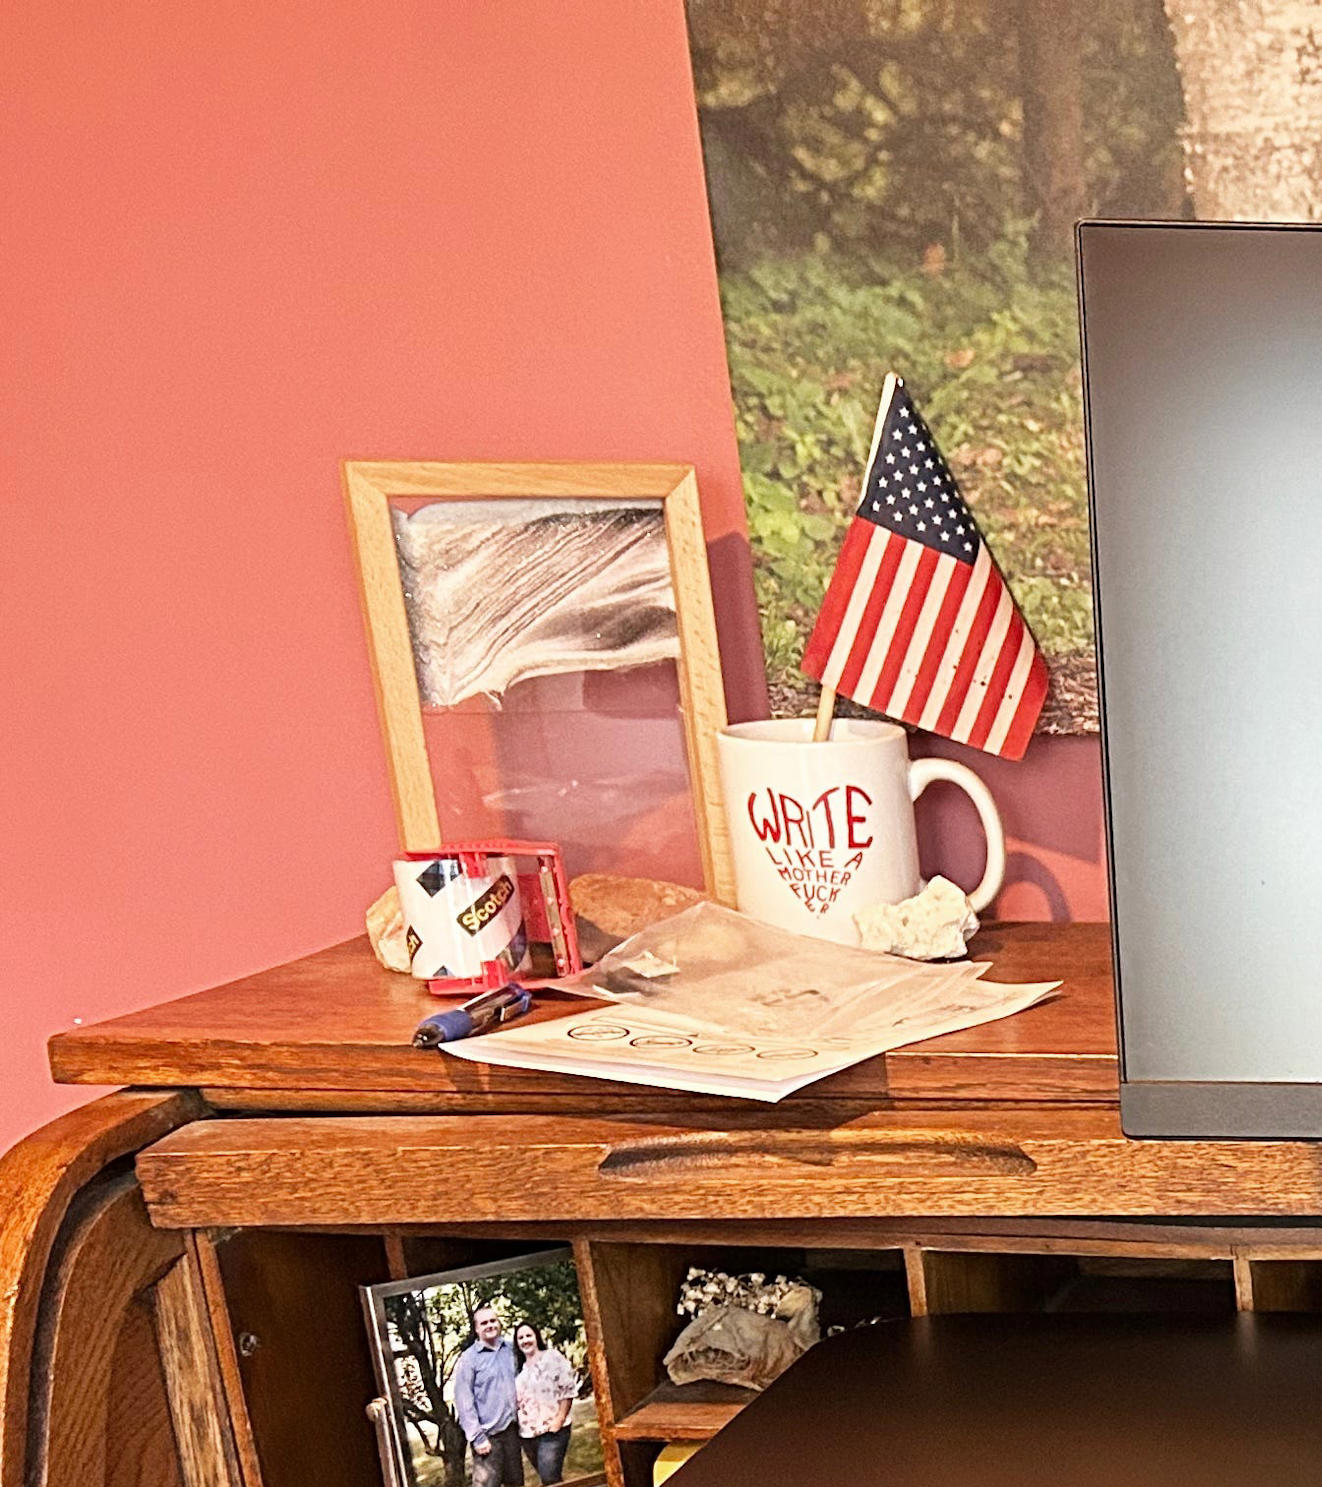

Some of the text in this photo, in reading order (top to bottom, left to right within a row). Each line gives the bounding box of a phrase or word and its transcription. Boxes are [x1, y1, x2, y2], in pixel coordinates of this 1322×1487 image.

[748, 785, 873, 849] WRITE
[765, 847, 863, 870] LIKE A
[777, 867, 851, 886] MOTHER
[789, 883, 841, 902] FUCK
[461, 879, 513, 930] Scotch
